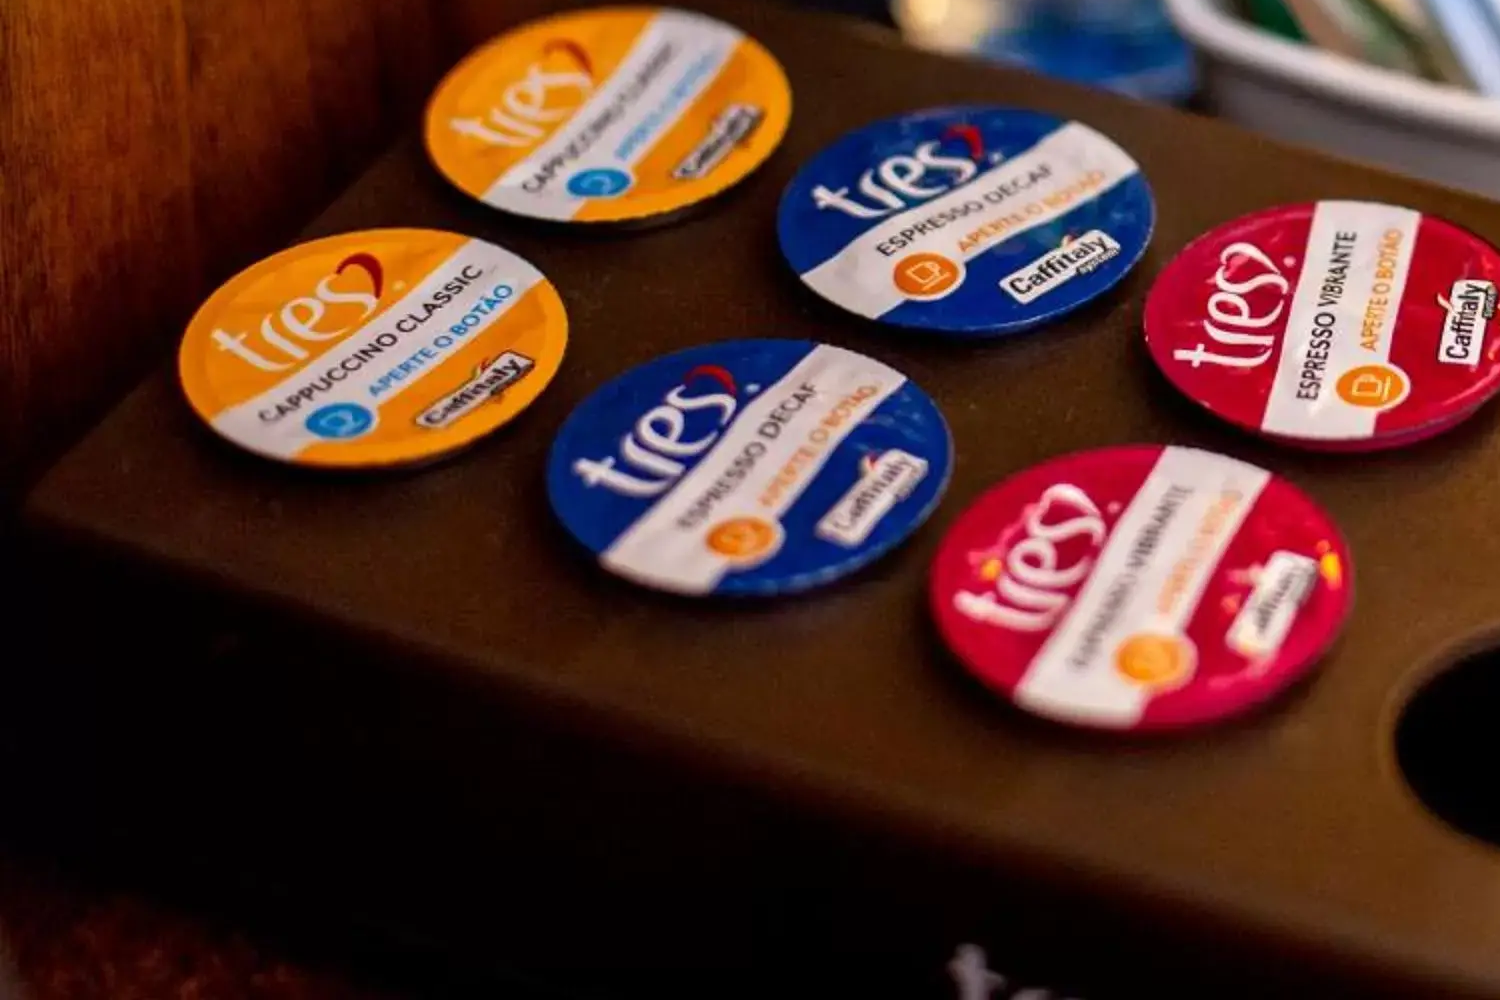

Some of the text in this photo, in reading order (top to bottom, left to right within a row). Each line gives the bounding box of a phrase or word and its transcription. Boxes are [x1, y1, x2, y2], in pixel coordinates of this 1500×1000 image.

[876, 163, 1053, 257] ESPRESSO DECAF
[1009, 236, 1117, 296] Caffitaly
[258, 264, 484, 424] CAPPUCCINO CLASSIC
[1297, 230, 1357, 401] ESPRESSO VIBRANTE
[1359, 294, 1387, 352] APERTE
[1374, 277, 1392, 294] O
[1446, 284, 1488, 360] Caffitaly
[368, 347, 438, 398] APERTE
[433, 334, 454, 349] O
[678, 381, 818, 529] ESPRESSO DECAF
